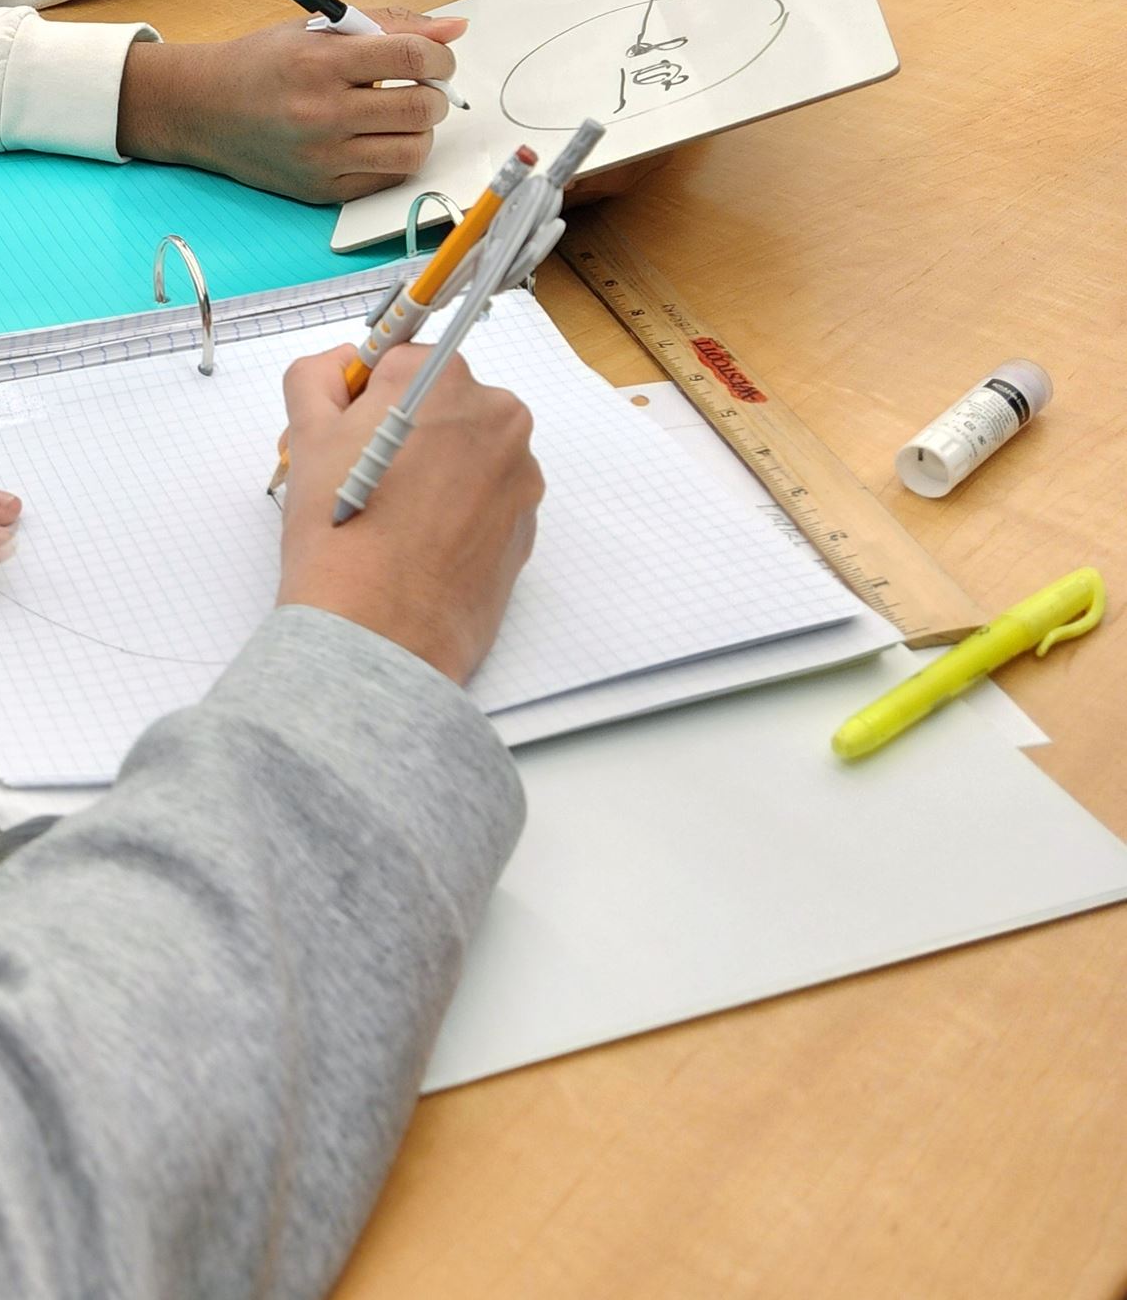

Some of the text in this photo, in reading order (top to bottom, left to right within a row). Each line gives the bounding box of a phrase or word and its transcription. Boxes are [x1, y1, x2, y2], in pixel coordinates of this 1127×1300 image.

[604, 279, 619, 288] 9
[631, 308, 645, 317] 8
[657, 340, 674, 348] 7
[691, 337, 756, 402] WESTCOTT
[689, 374, 704, 382] 6
[721, 409, 737, 417] 5
[755, 447, 771, 457] 4
[791, 486, 808, 497] 3
[829, 531, 849, 541] 2
